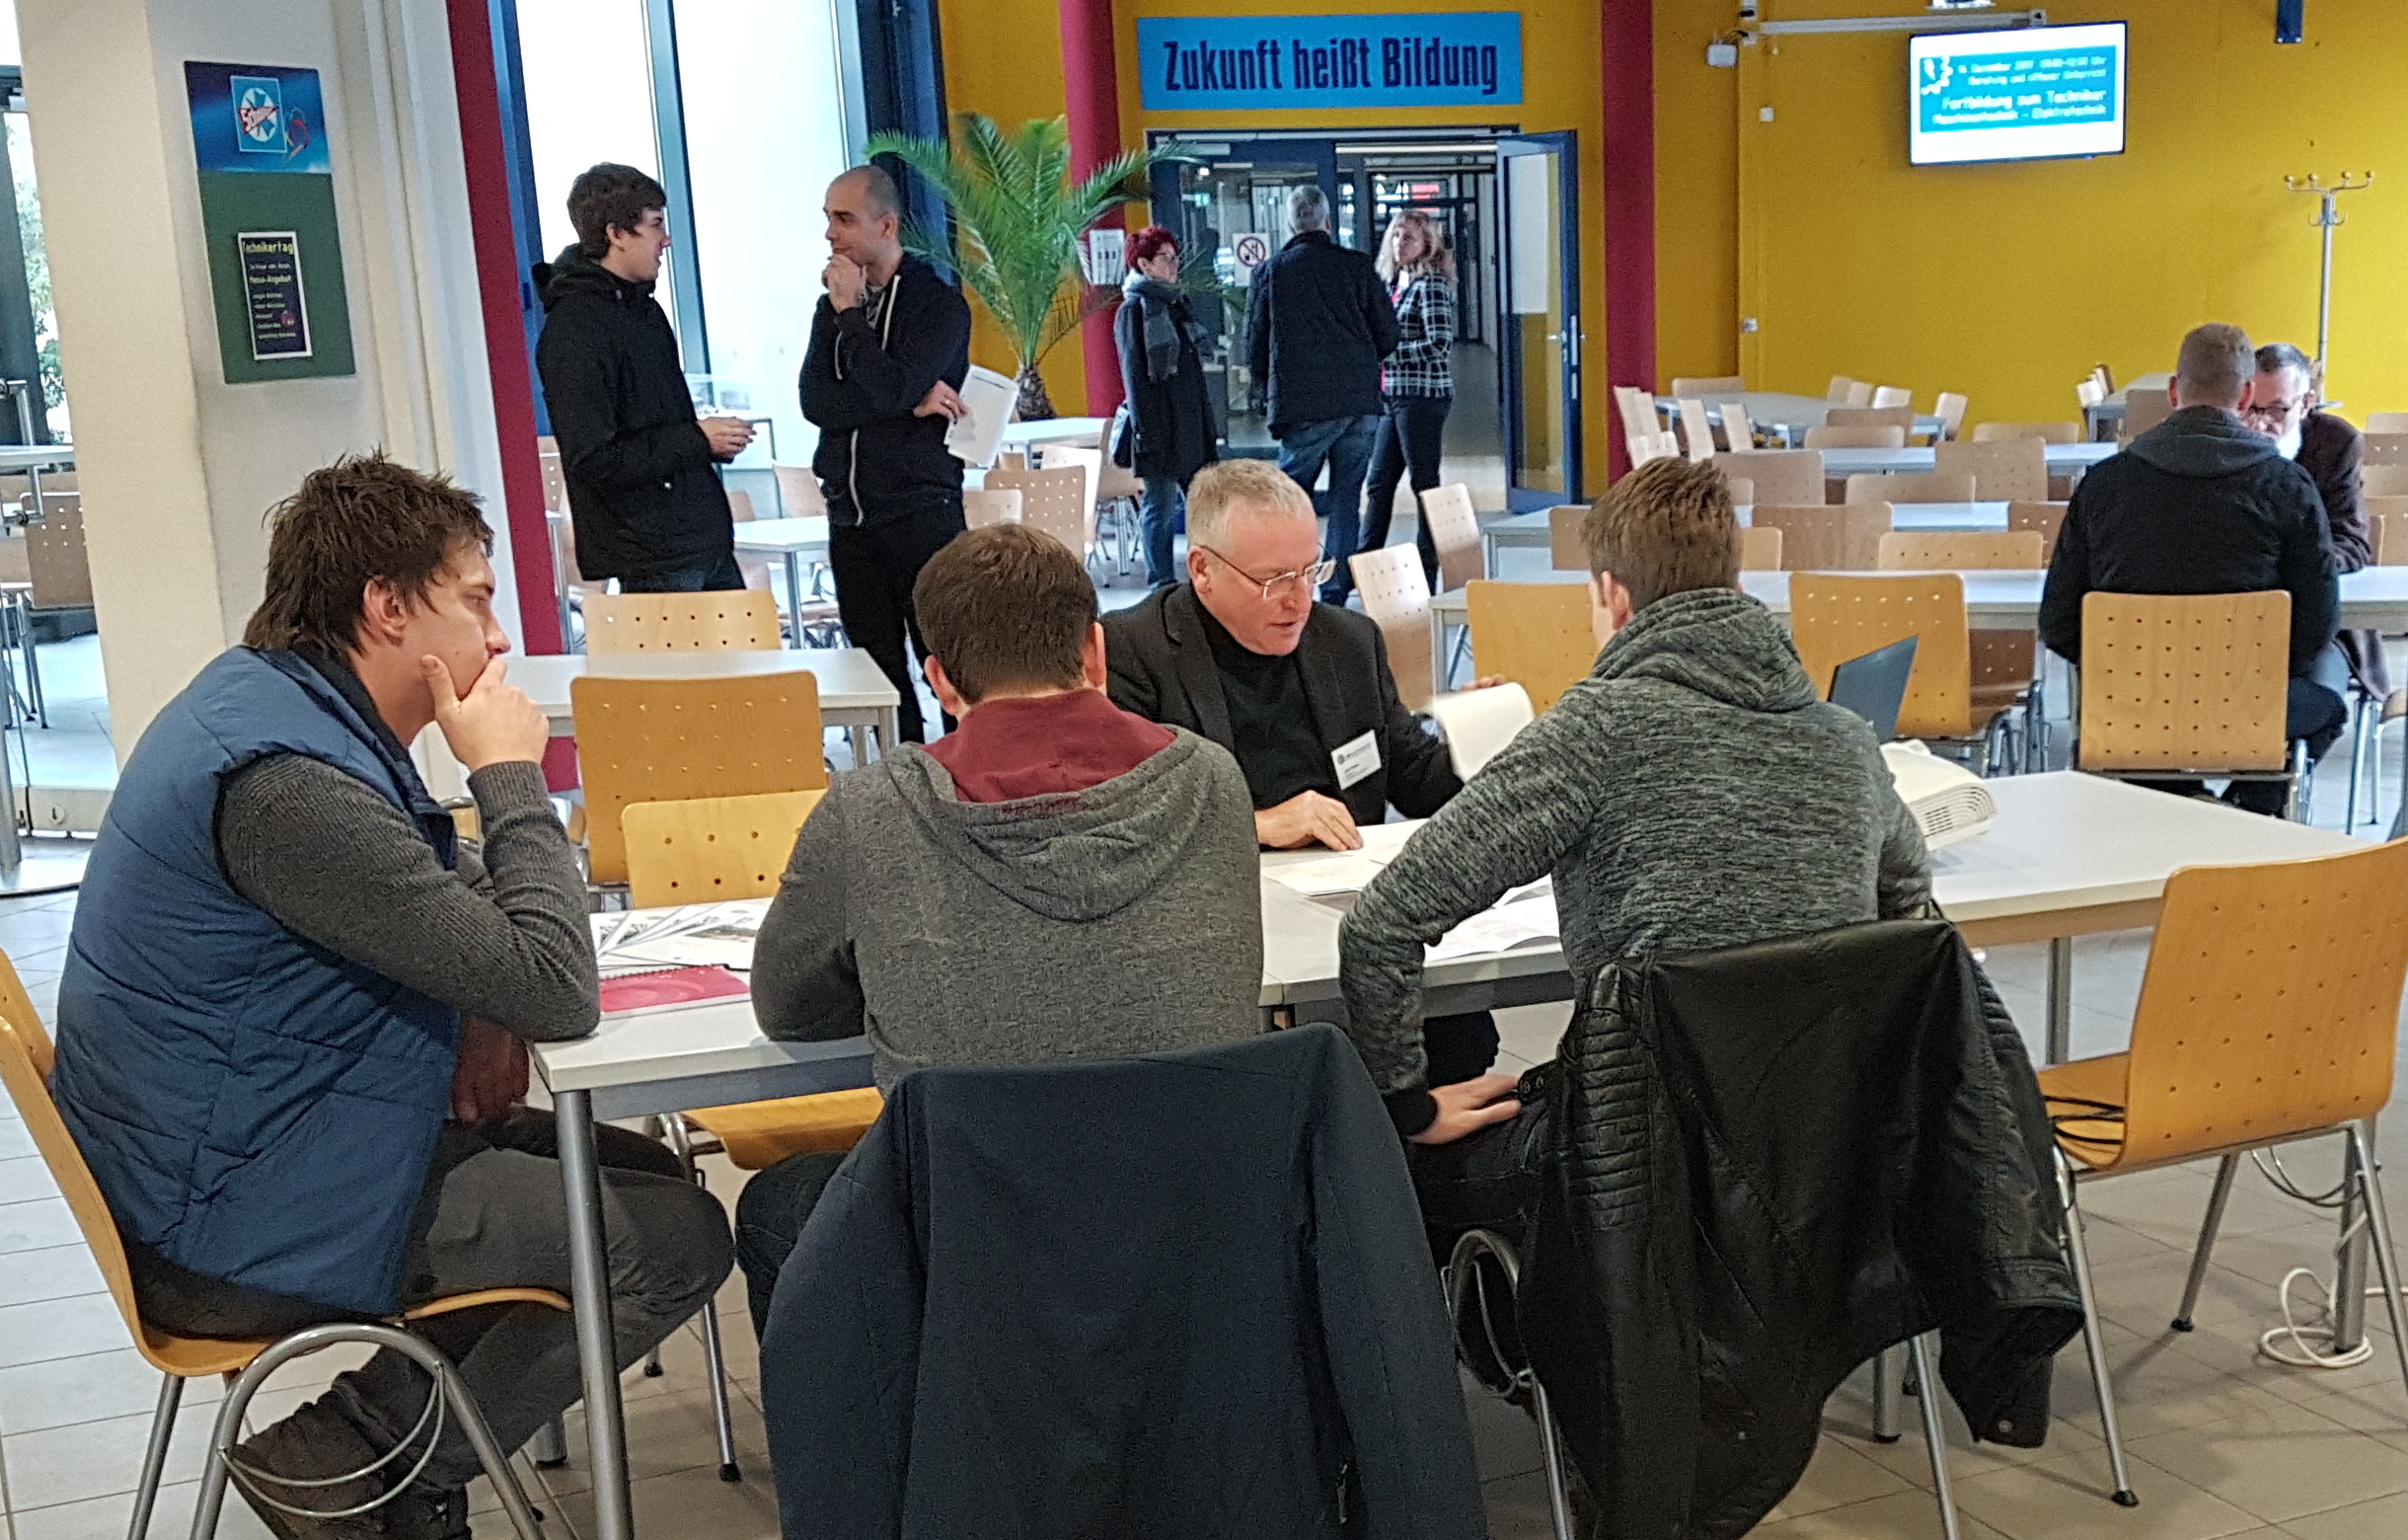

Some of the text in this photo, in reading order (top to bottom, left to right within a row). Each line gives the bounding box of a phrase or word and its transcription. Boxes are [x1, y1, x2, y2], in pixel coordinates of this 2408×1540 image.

[1164, 38, 1498, 95] Zukunft heißt Bildung
[2047, 90, 2106, 103] Techniker
